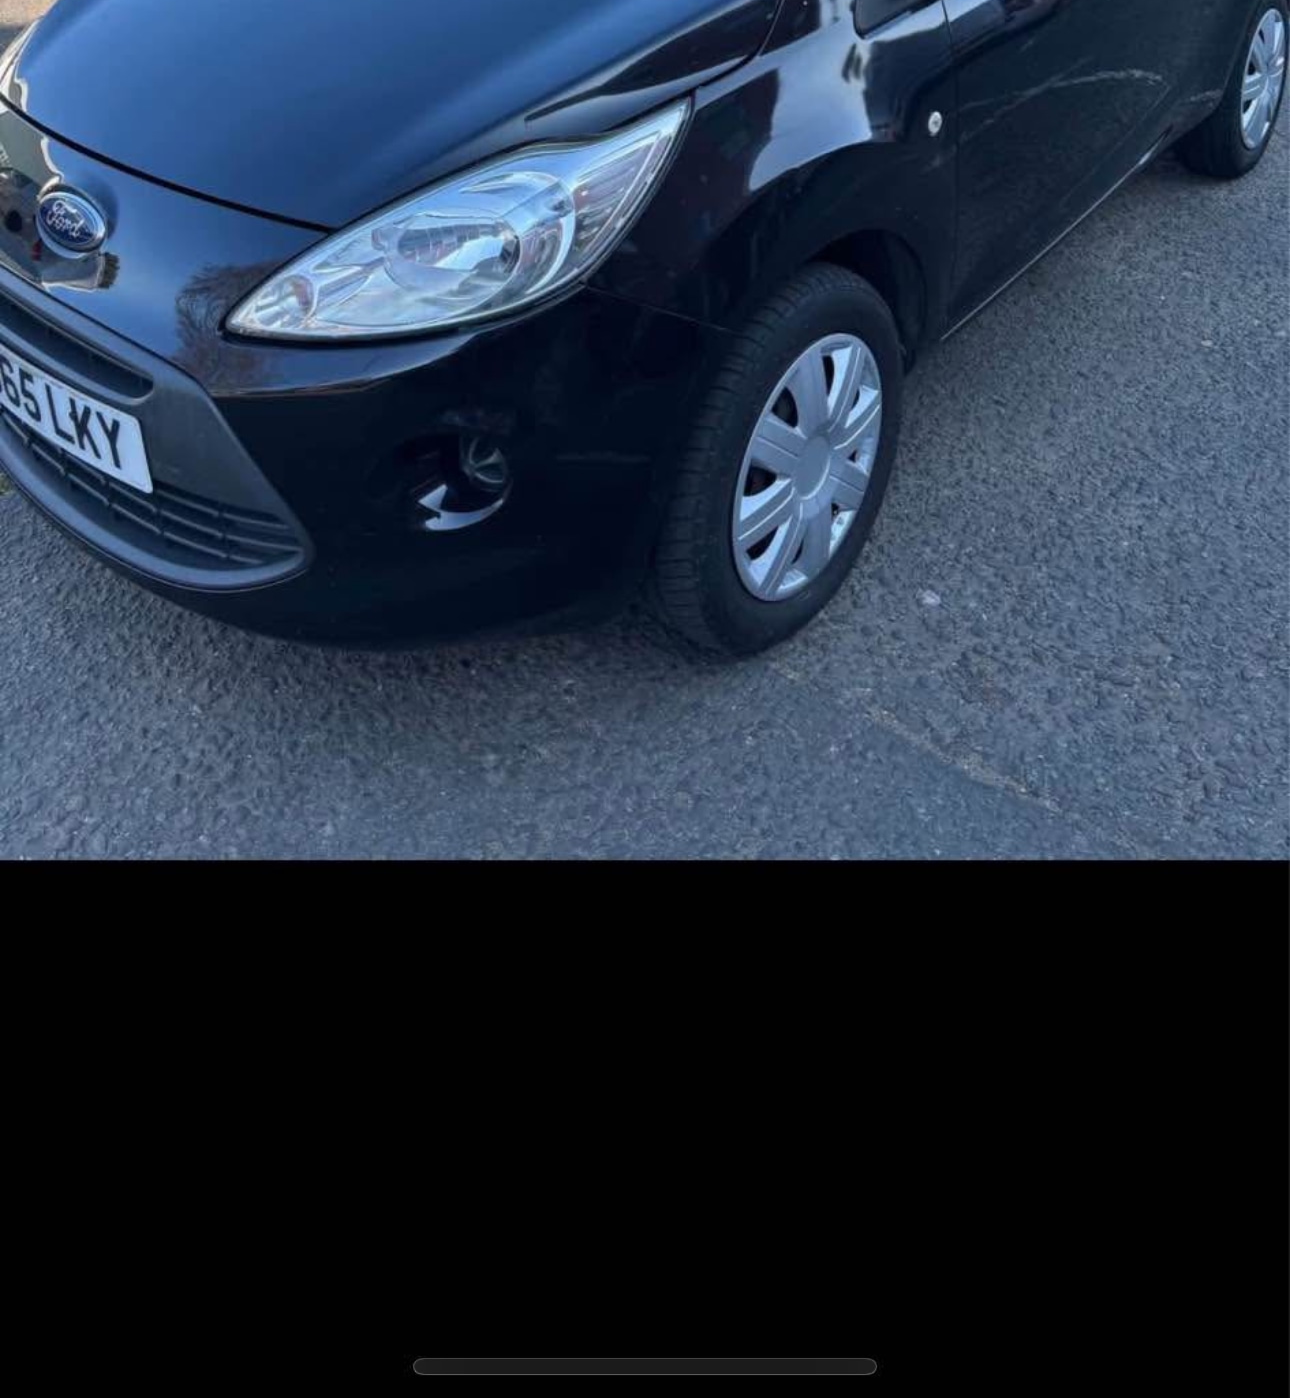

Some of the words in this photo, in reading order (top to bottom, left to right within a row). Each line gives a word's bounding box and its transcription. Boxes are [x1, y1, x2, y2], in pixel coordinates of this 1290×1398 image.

[45, 200, 84, 238] Ford
[0, 354, 42, 423] 65
[45, 382, 122, 470] LKY
